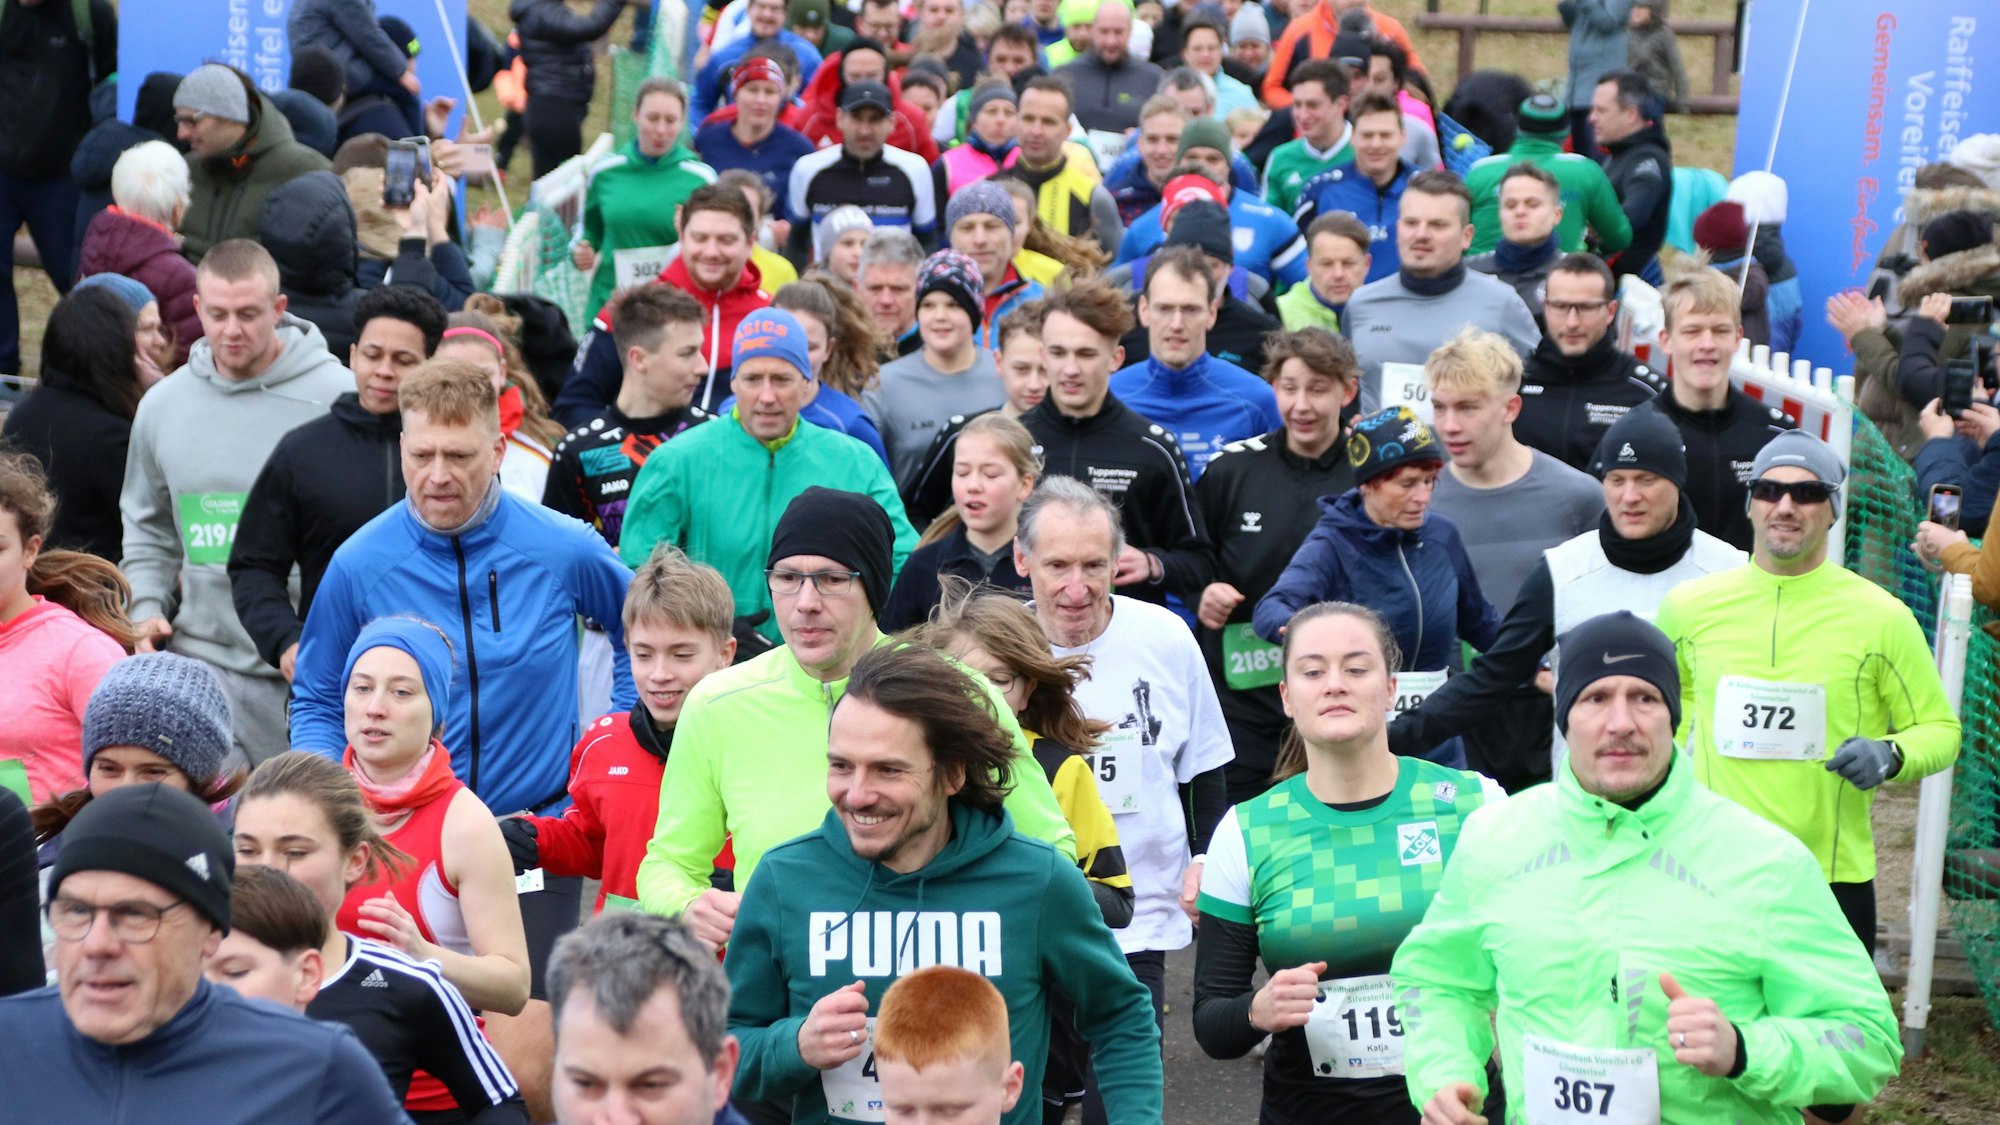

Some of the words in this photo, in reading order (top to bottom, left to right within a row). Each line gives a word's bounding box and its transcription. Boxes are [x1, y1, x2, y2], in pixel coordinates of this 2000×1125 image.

[1861, 12, 1898, 167] Gemeinsam.
[1521, 385, 1545, 395] JAKO
[1585, 402, 1632, 412] Tupperwar
[1088, 466, 1138, 478] Tupperware
[601, 479, 629, 494] JAKO
[1231, 647, 1284, 674] 2189
[1742, 703, 1796, 730] 372
[608, 766, 629, 775] JAKO
[809, 911, 1002, 977] PUMA
[361, 979, 388, 988] adidas
[1342, 1005, 1406, 1041] 119
[1367, 1044, 1389, 1052] Katja
[1554, 1076, 1616, 1117] 367
